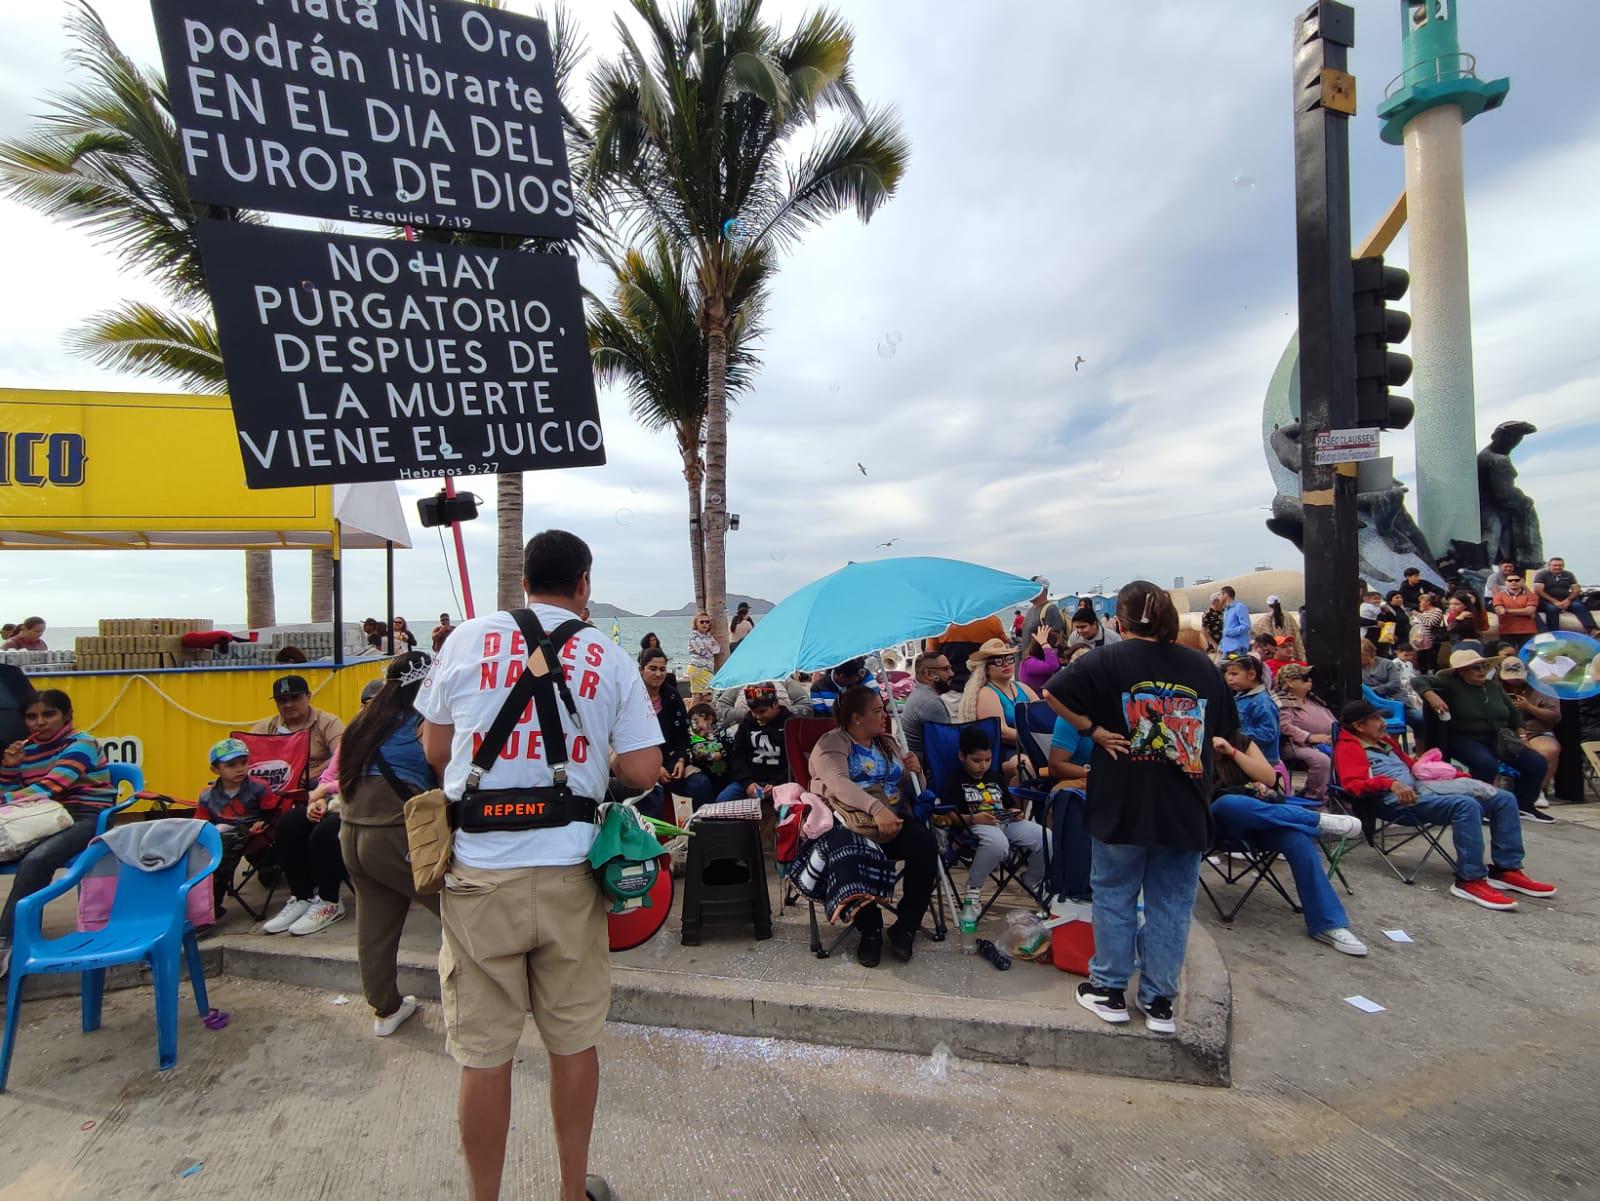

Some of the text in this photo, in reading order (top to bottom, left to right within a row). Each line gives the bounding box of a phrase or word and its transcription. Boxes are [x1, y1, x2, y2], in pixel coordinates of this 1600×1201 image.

[258, 0, 537, 62] ata Ni Oro
[183, 17, 543, 115] podrán librarte
[187, 65, 553, 167] EN EL DIA DEL
[181, 128, 574, 217] FUROR DE DIOS
[348, 205, 472, 229] Ezequiel 7:19
[328, 242, 499, 290] NO HAY
[254, 285, 566, 337] PURGATORIO,
[274, 333, 559, 374] DESPUES DE
[298, 381, 555, 421] LA MUERTE
[239, 420, 603, 470] VIENE EL JUICIO
[400, 462, 499, 480] Hebreos 9:27
[483, 630, 604, 667] DEES
[97, 740, 137, 764] CO
[472, 730, 588, 763] NUEO
[483, 803, 545, 816] REPENT
